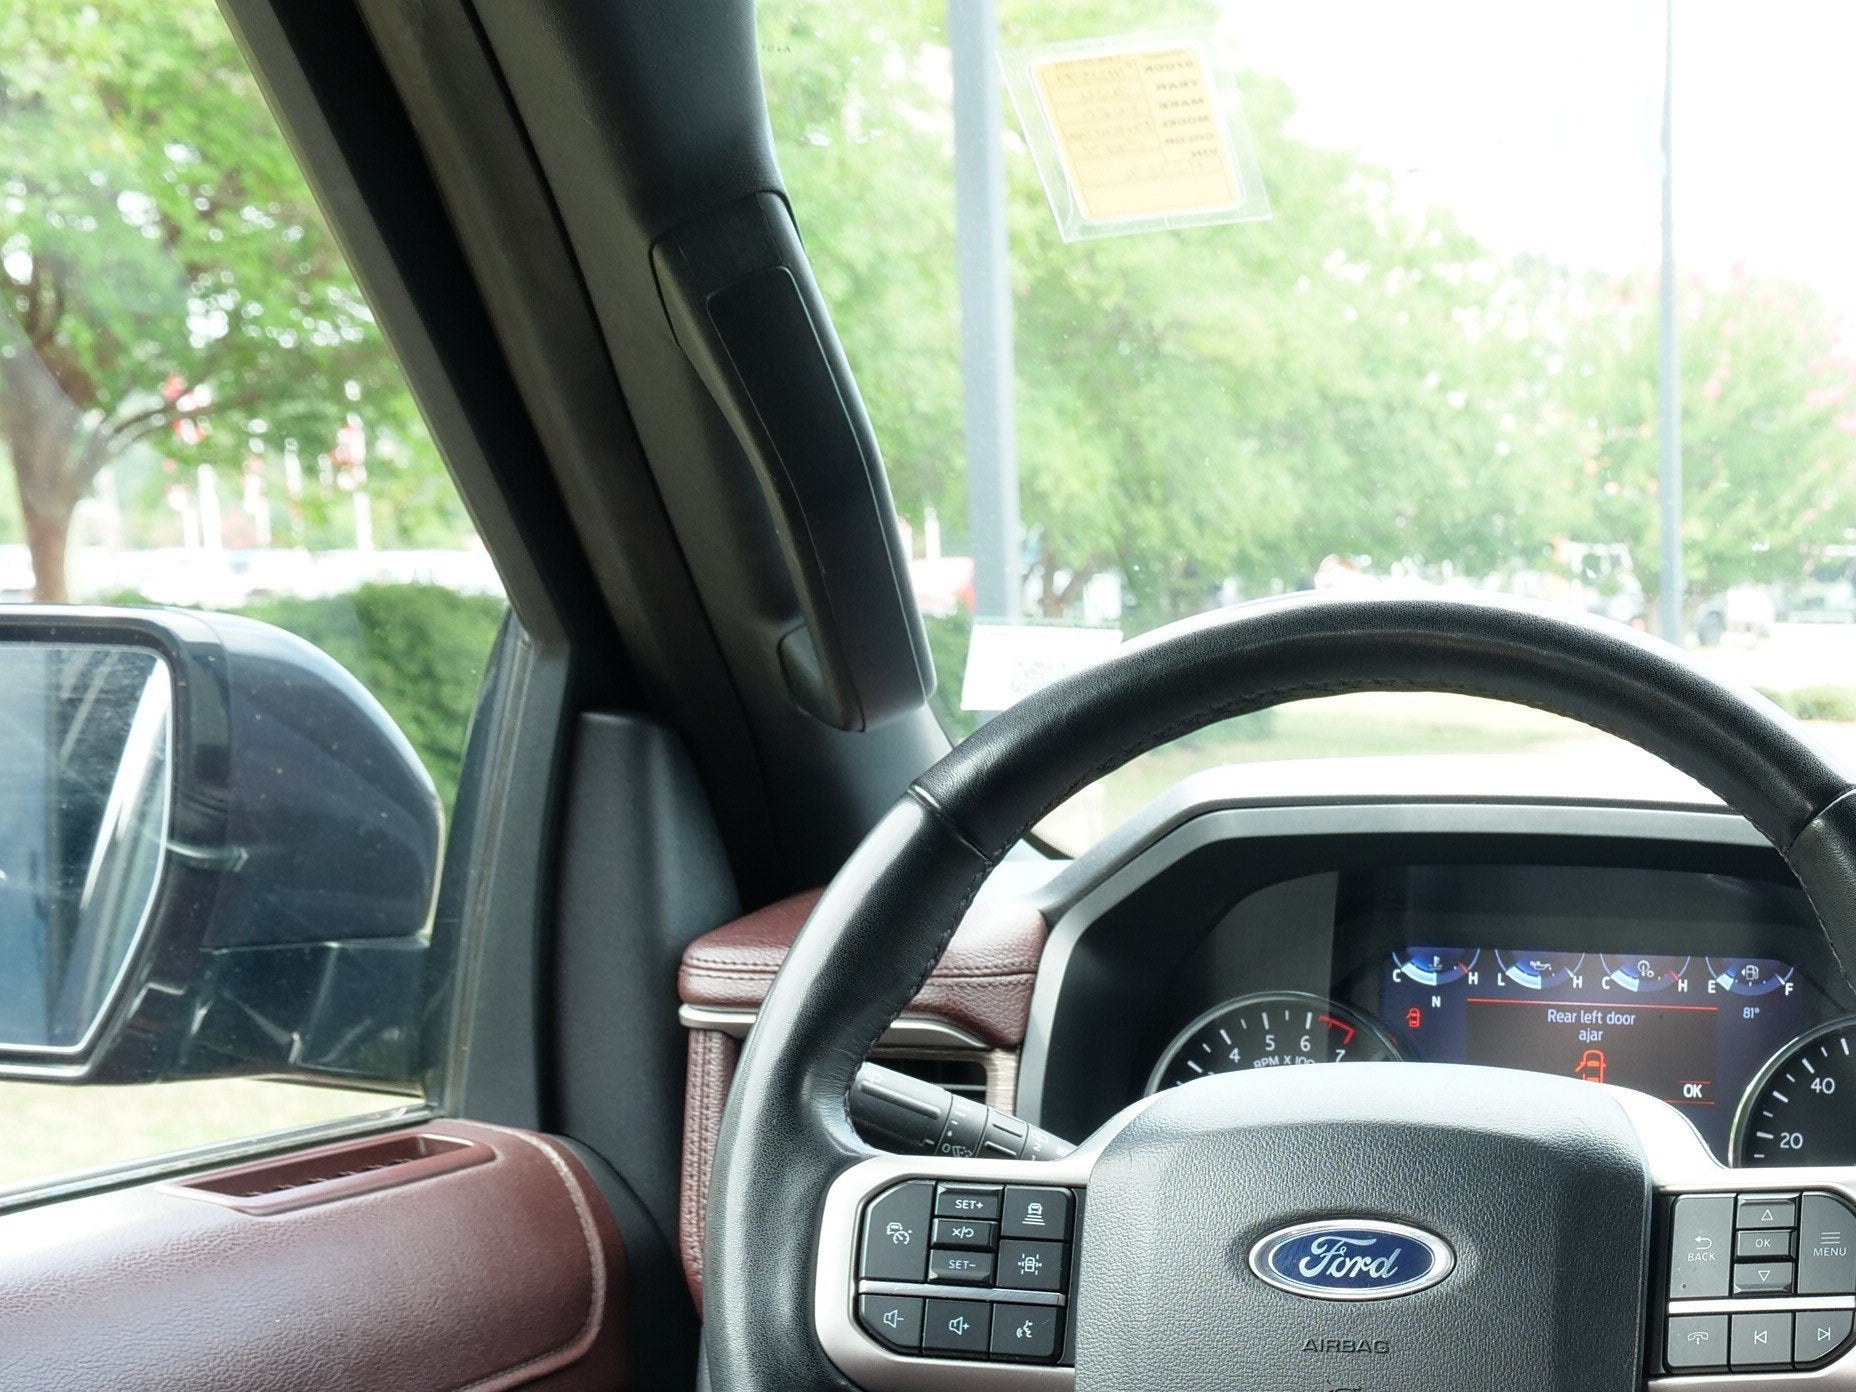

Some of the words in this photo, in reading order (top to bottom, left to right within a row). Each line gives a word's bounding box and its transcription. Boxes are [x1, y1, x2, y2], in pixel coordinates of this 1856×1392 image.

[1392, 968, 1401, 983] C
[1468, 972, 1478, 985] H
[1498, 973, 1505, 986] L
[1573, 976, 1582, 989] H
[1601, 976, 1610, 989] C
[1678, 979, 1687, 992] H
[1708, 980, 1716, 993] E
[1785, 982, 1793, 996] F
[1432, 995, 1441, 1008] N
[1548, 1009, 1576, 1023] Rear
[1581, 1011, 1602, 1024] left
[1606, 1011, 1636, 1025] door
[1579, 1028, 1603, 1043] ajar
[1265, 1035, 1275, 1051] 5
[1300, 1035, 1311, 1051] 6
[1229, 1047, 1240, 1063] 4
[1253, 1055, 1279, 1068] RPM
[1335, 1049, 1345, 1062] 7
[1683, 1084, 1702, 1098] OK
[1810, 1077, 1835, 1095] 40
[1780, 1132, 1803, 1149] 20
[955, 1199, 983, 1210] SET+
[1755, 1238, 1771, 1248] OK
[1299, 1235, 1402, 1278] Ford
[1687, 1252, 1716, 1262] BACK
[1813, 1247, 1847, 1257] MENU
[1302, 1338, 1389, 1354] AIRBAG
